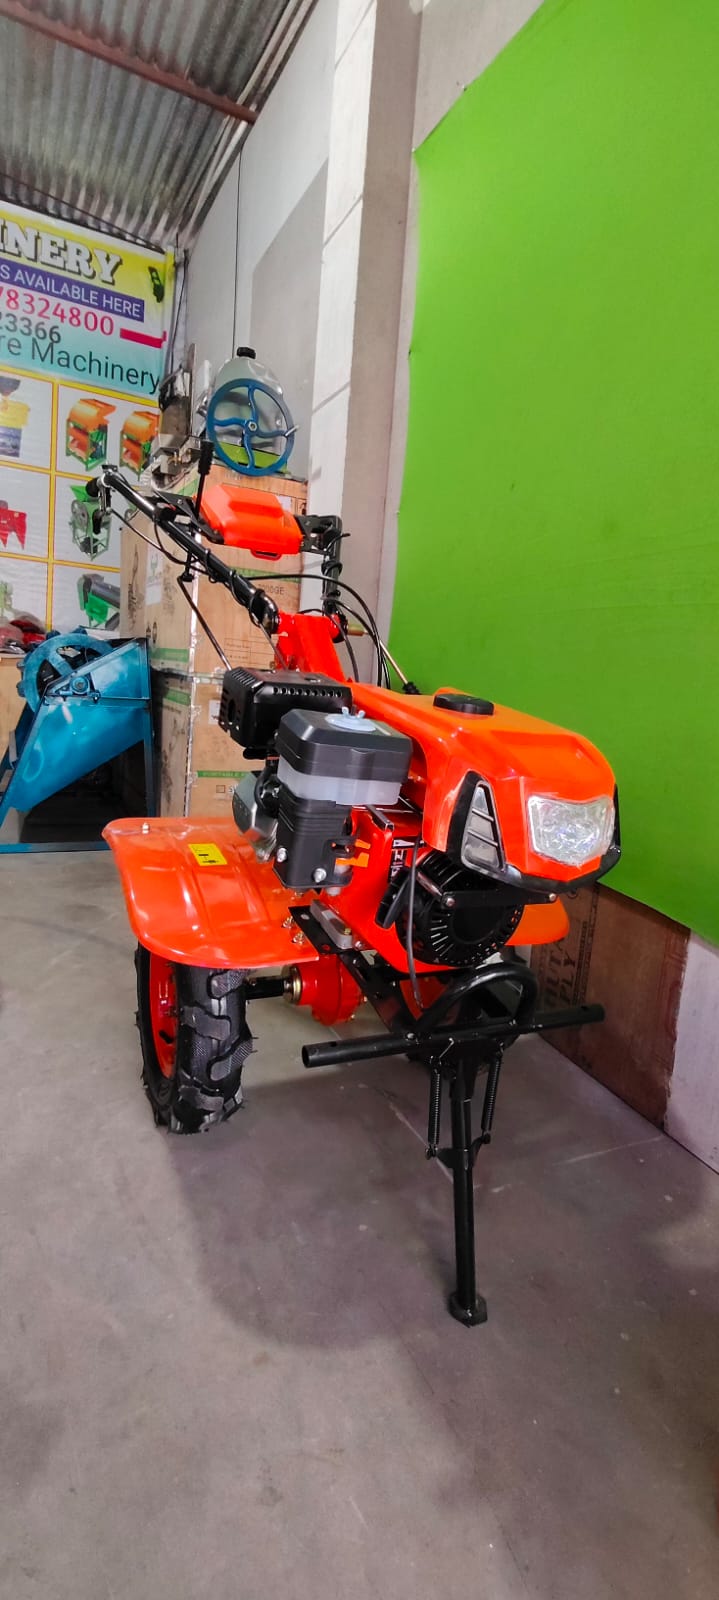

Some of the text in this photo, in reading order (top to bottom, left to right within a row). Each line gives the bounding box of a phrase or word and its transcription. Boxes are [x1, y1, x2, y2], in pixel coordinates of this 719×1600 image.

[0, 286, 115, 336] 8324800
[13, 269, 99, 306] AVAILABLE
[103, 294, 141, 318] HERE
[0, 311, 61, 344] 3366
[31, 337, 160, 395] Machinery
